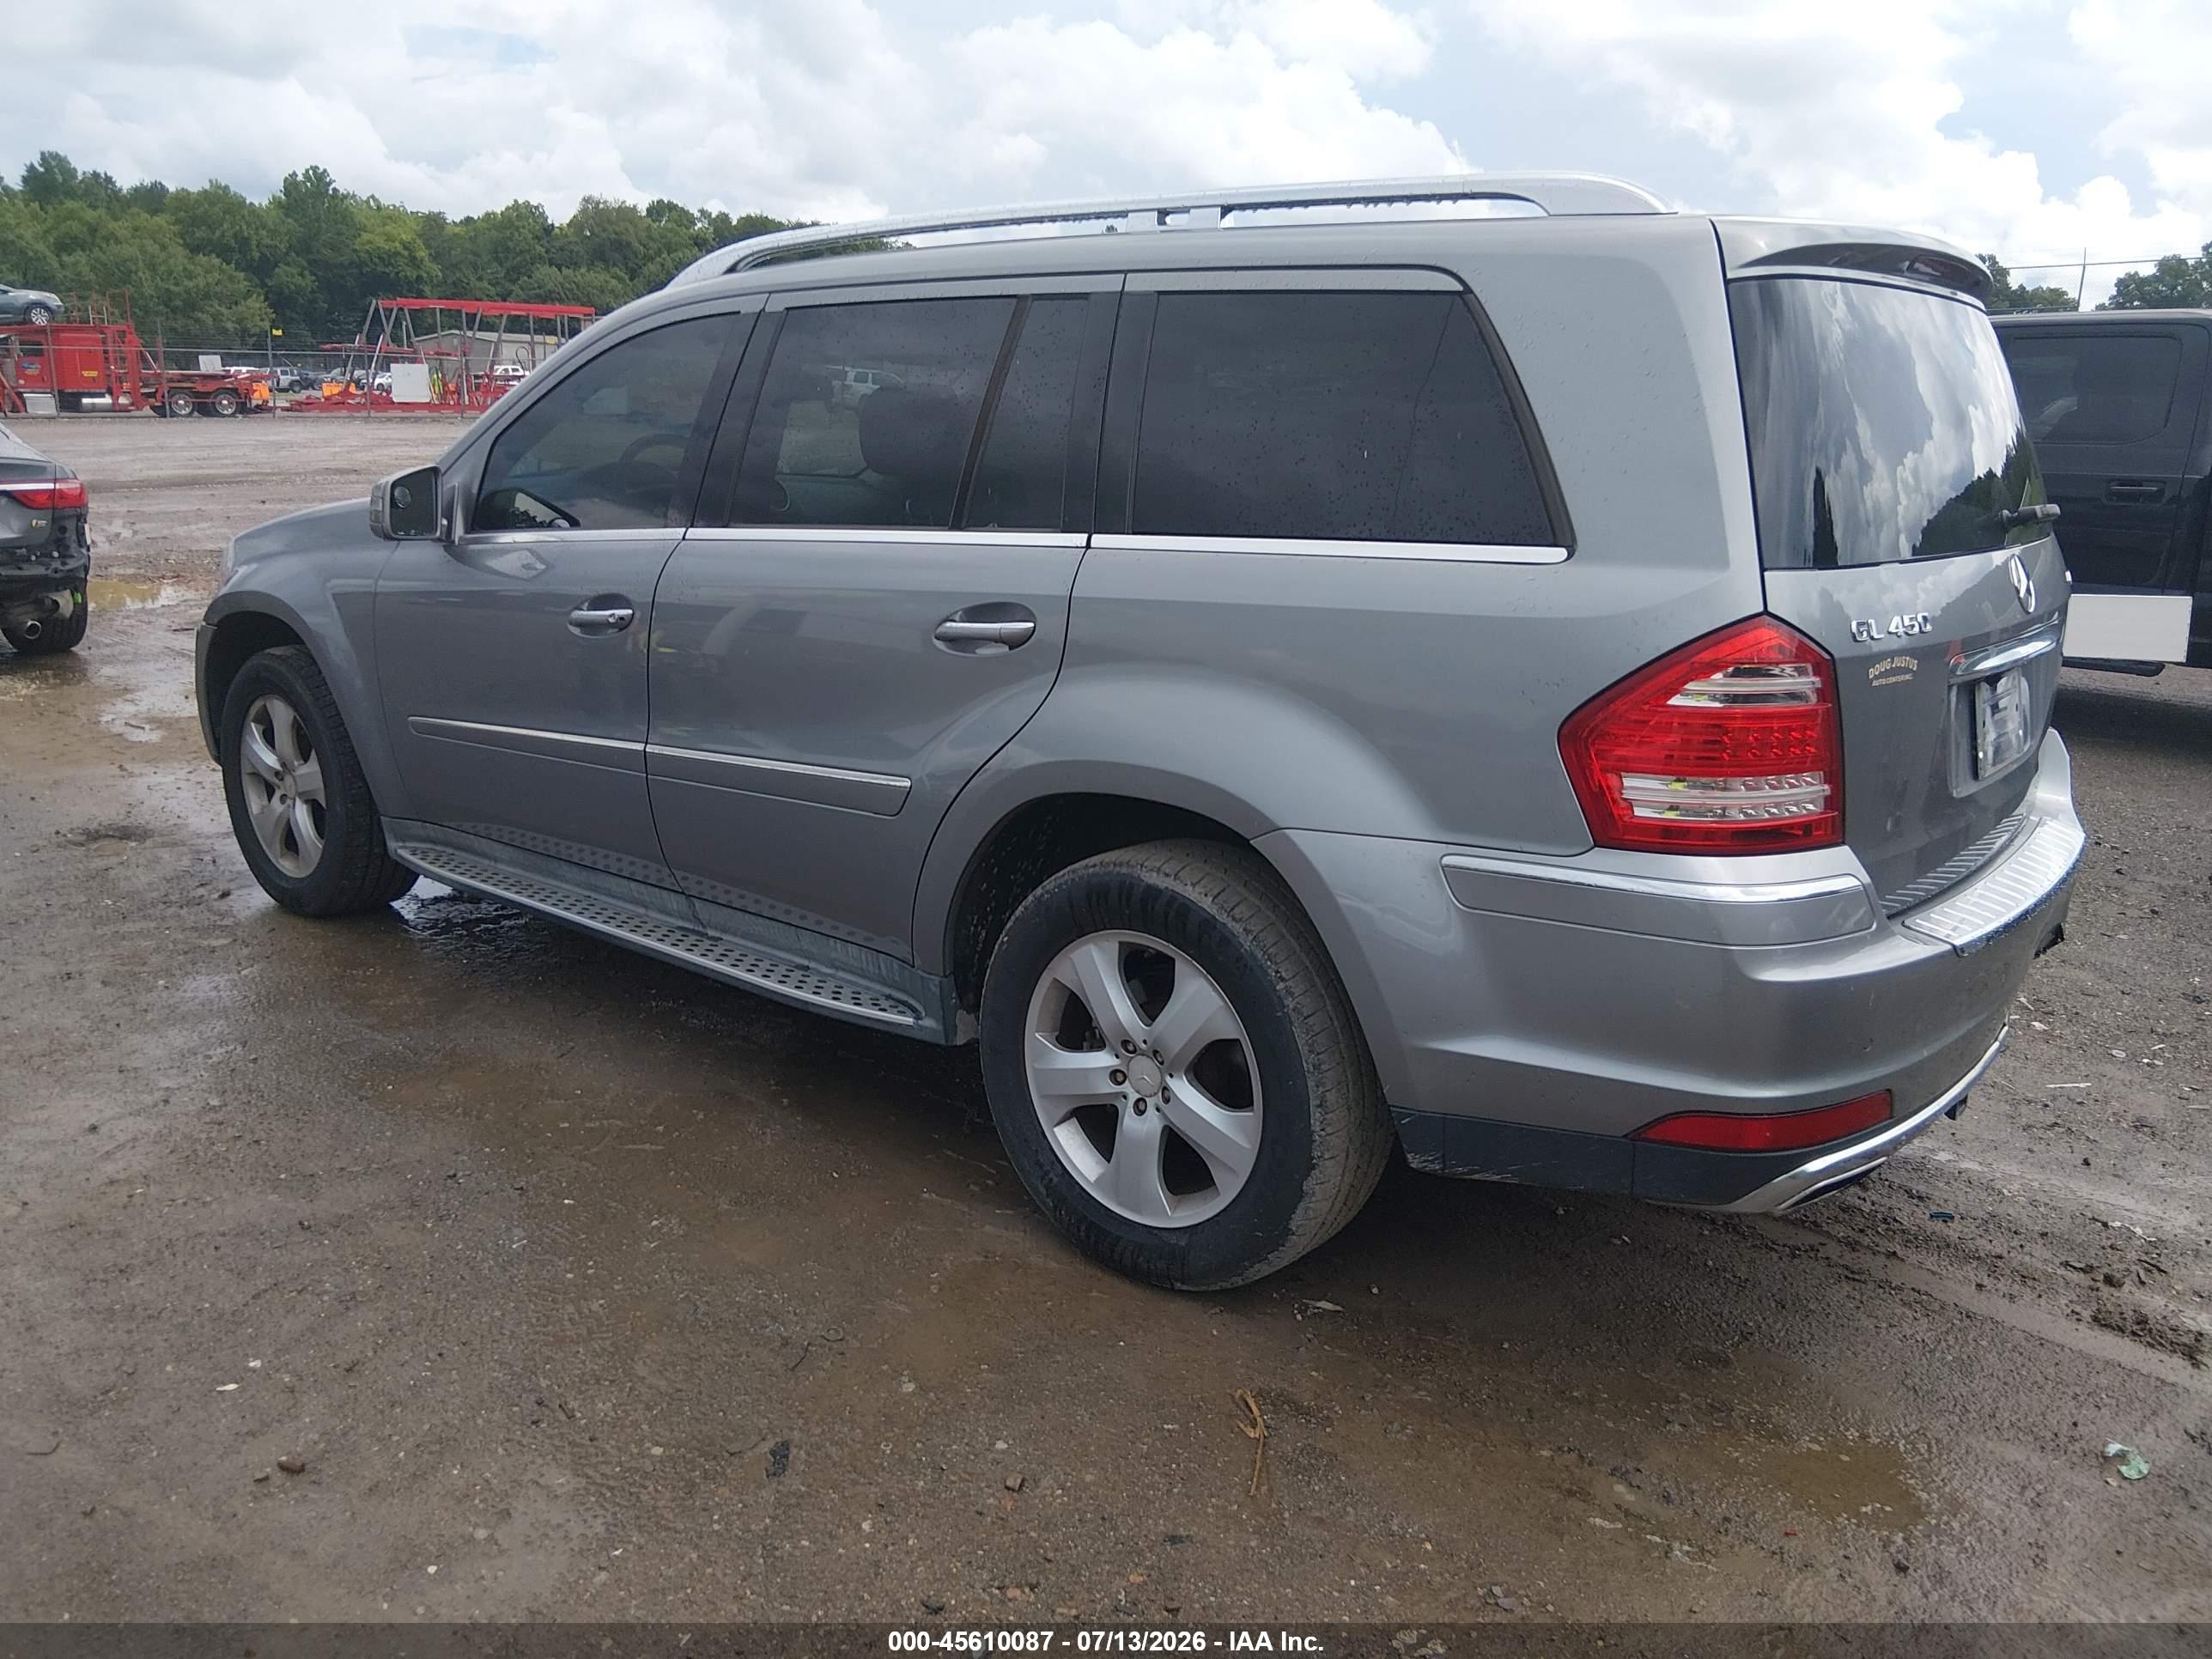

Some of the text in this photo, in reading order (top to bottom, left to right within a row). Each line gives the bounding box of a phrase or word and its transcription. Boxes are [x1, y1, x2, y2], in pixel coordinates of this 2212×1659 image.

[1850, 618, 1885, 642] GL
[1868, 655, 1918, 679] DOUG JUSTUS
